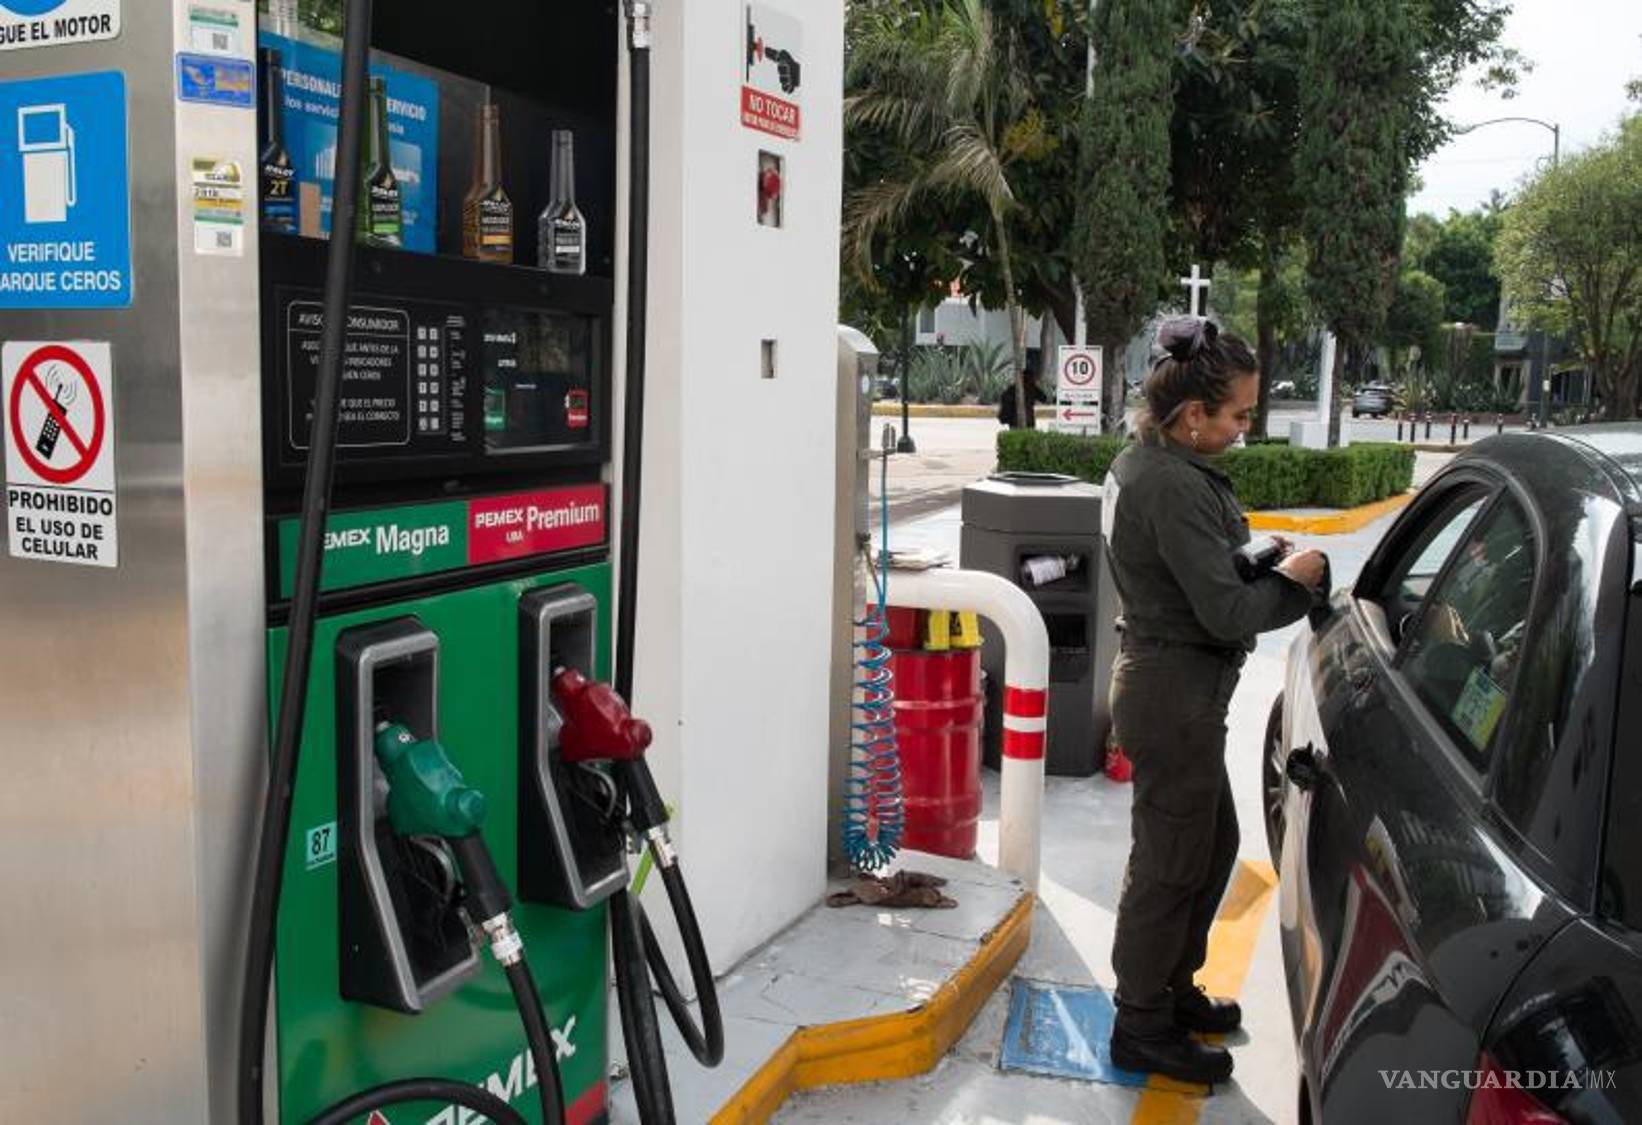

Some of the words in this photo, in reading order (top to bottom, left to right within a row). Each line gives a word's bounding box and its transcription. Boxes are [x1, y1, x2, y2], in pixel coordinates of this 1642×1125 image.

[31, 21, 49, 40] EL
[54, 14, 111, 38] MOTOR
[749, 93, 764, 113] NO
[765, 98, 796, 125] TOCAR
[270, 181, 289, 196] 2T
[8, 242, 96, 262] VERIFIQUE
[0, 272, 57, 291] ARQUE
[61, 270, 121, 291] CEROS
[1072, 361, 1088, 375] 10
[9, 490, 113, 516] PROHIBIDO
[16, 517, 35, 534] EL
[41, 519, 75, 537] USO
[81, 523, 102, 540] DE
[475, 508, 524, 529] PEMEX
[527, 501, 599, 532] Premium
[22, 537, 98, 560] CELULAR
[324, 528, 371, 550] EMEX
[376, 524, 450, 555] Magna
[311, 826, 331, 855] 87
